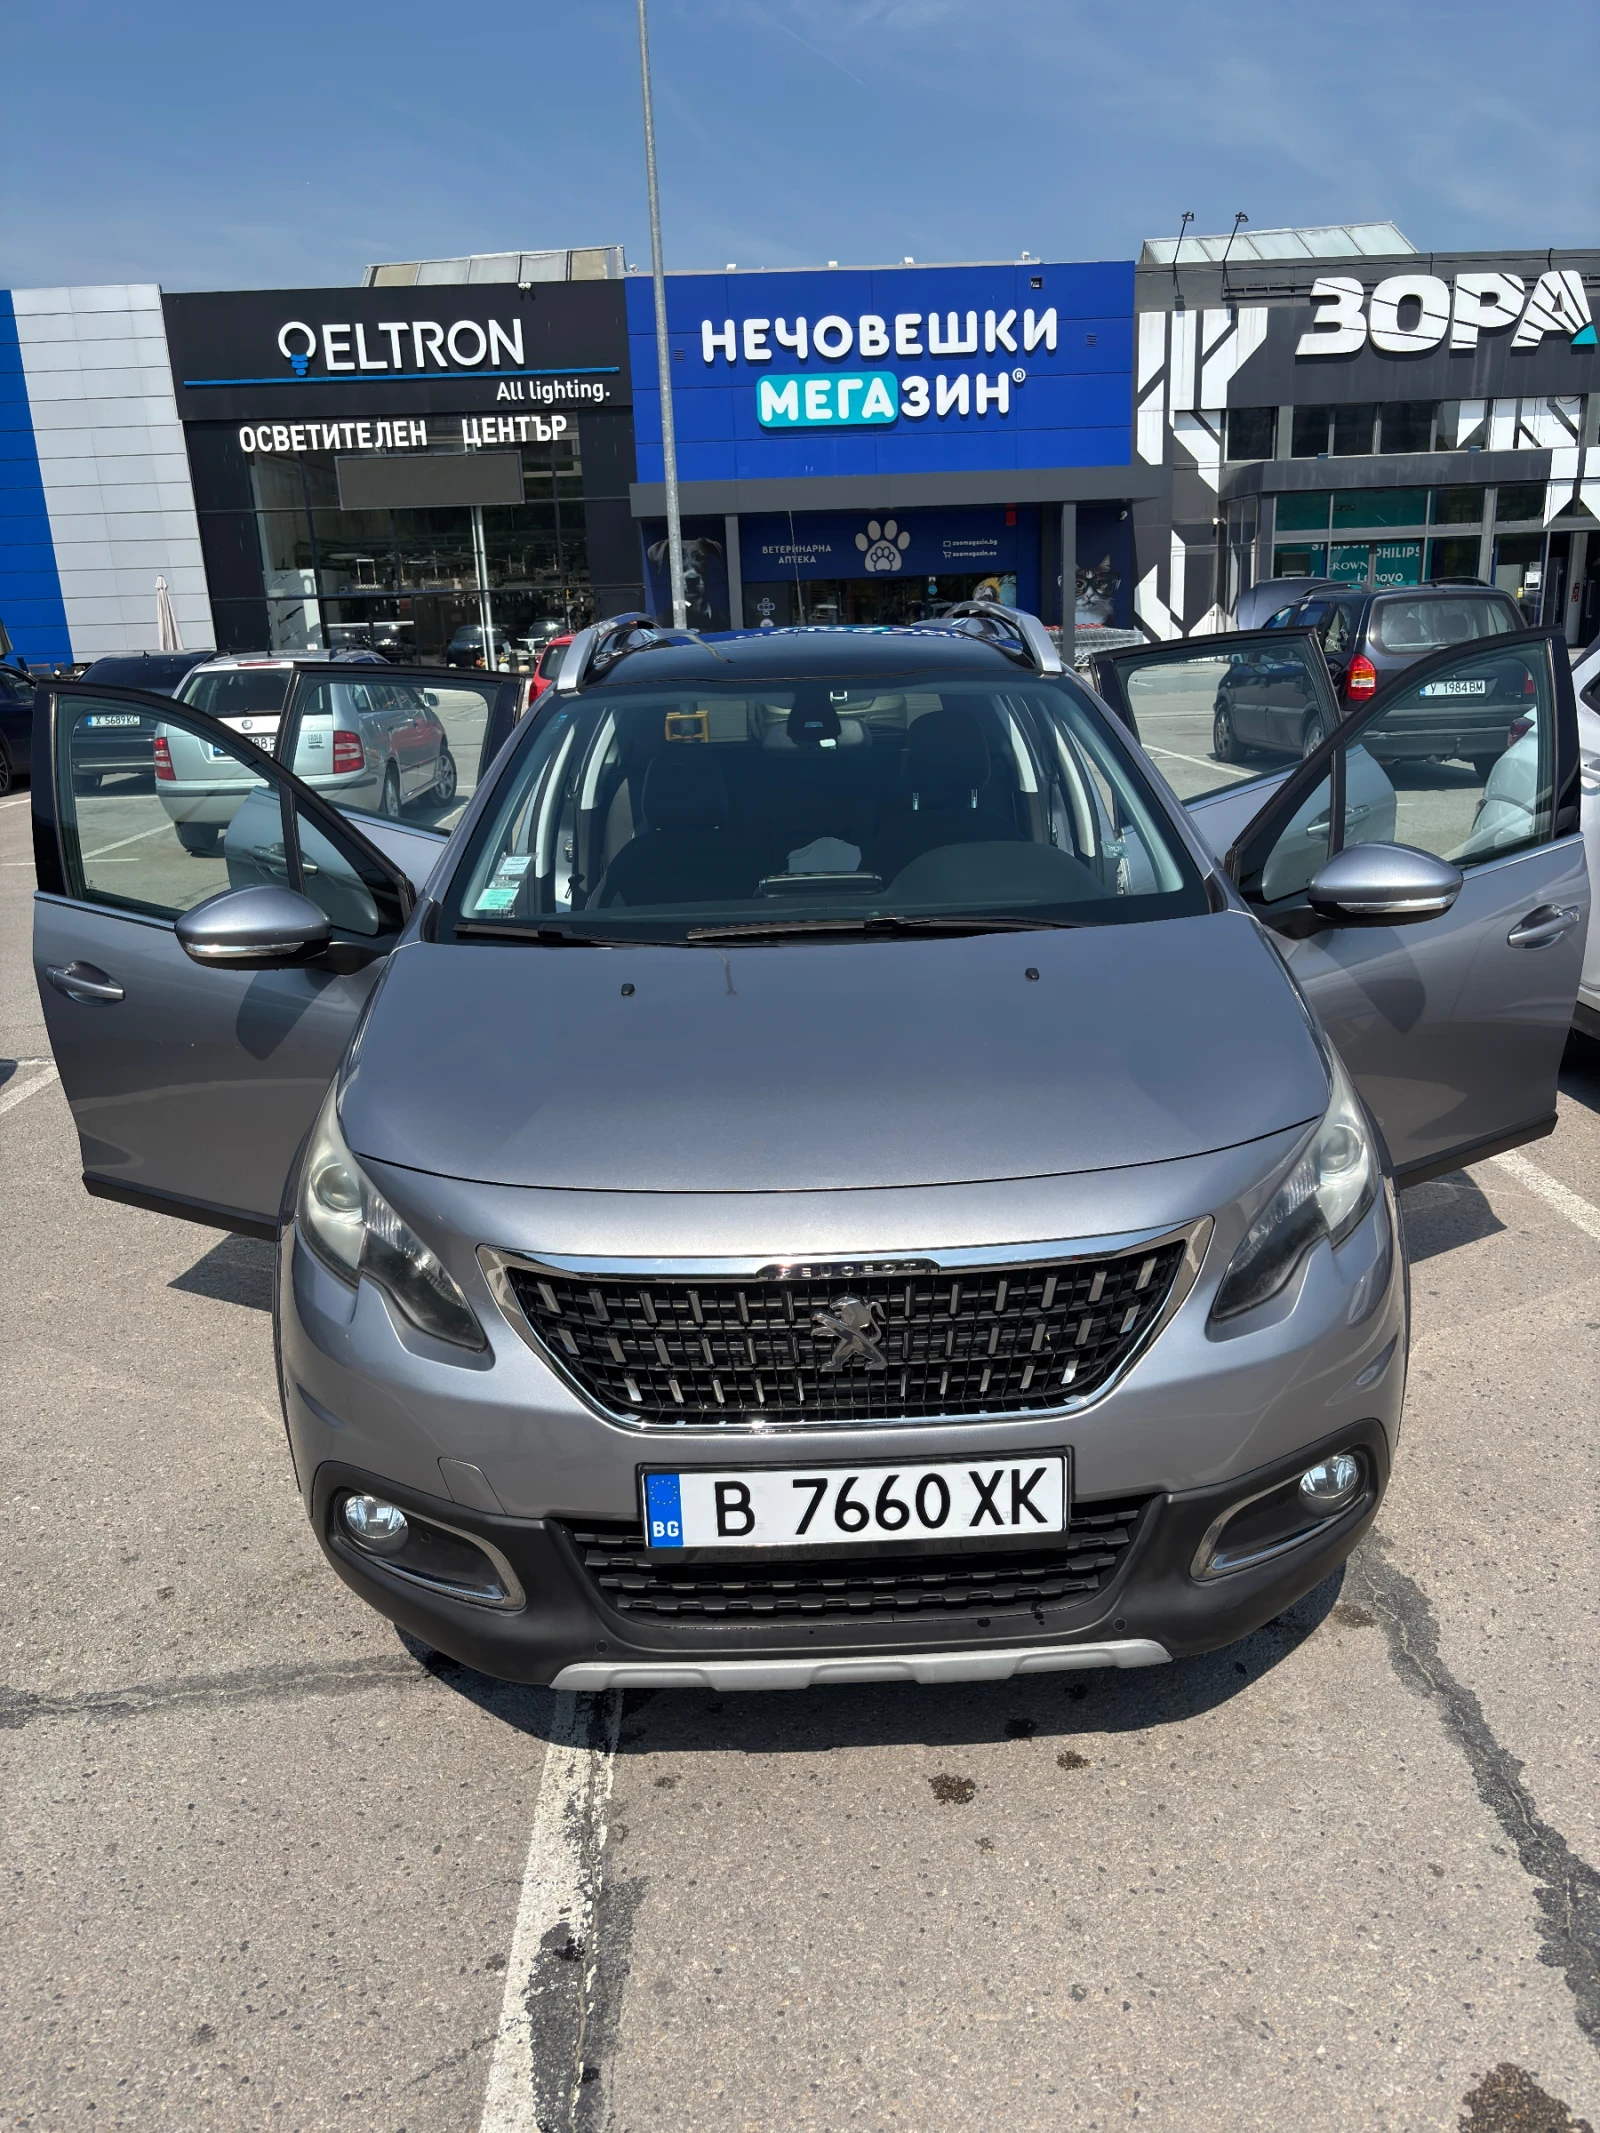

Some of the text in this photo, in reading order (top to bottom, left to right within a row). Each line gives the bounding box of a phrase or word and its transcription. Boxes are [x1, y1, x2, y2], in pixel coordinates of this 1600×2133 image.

[1295, 270, 1598, 356] ЗОРА
[701, 307, 1058, 363] НЕЧОВЕШКИ
[496, 378, 612, 405] All lighting.
[239, 415, 567, 453] ОСВЕТИТЕЛЕН ЦЕНТЪР
[762, 544, 832, 555] ВЕТЕРИНАРНА
[778, 555, 817, 565] АПТЕКА
[1444, 681, 1468, 693] 1984
[777, 1262, 917, 1279] PEUGEOT
[652, 1466, 1049, 1538] BG B 7660 XK
